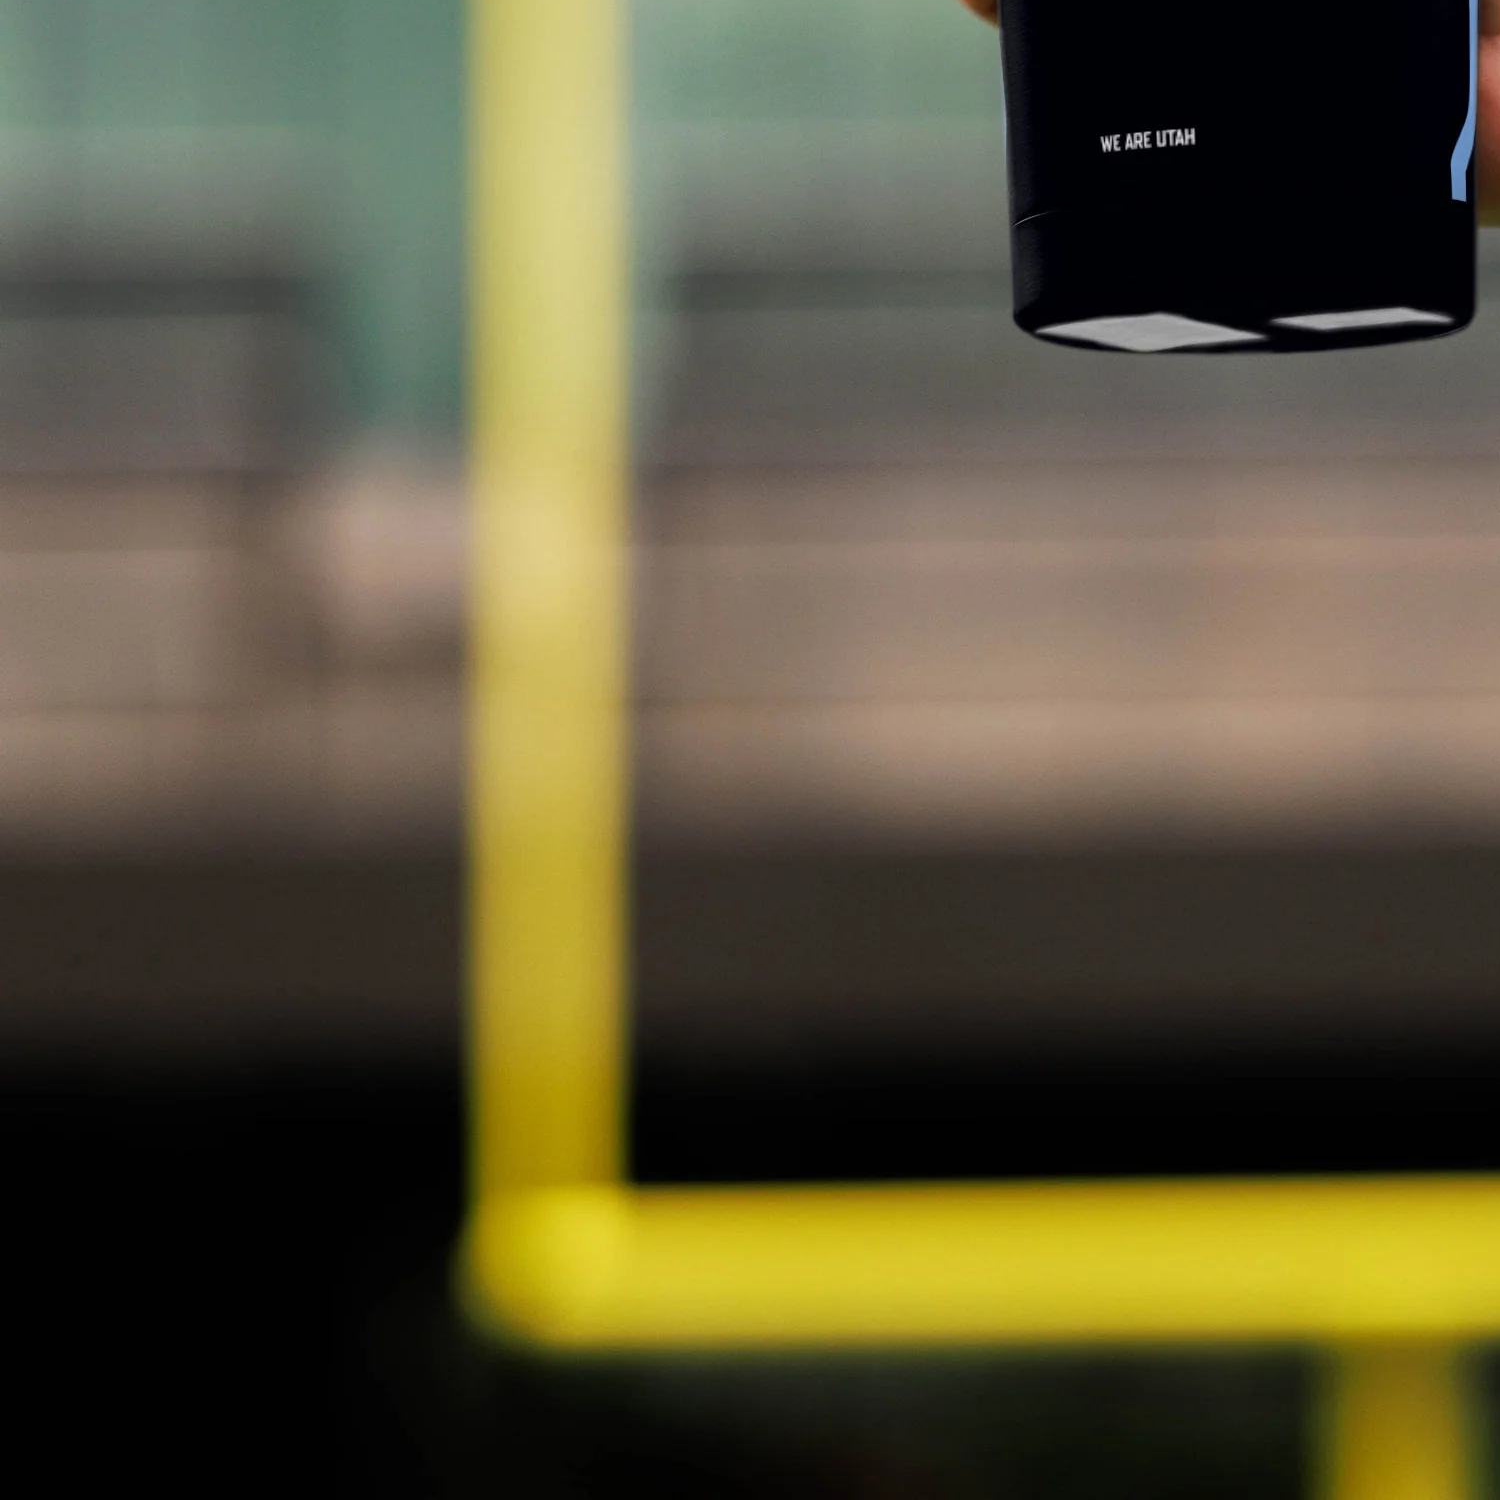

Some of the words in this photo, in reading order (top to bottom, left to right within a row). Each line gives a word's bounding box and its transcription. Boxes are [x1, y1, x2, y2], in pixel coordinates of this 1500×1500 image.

[1100, 134, 1121, 153] WE
[1125, 131, 1152, 150] ARE
[1156, 128, 1196, 148] UTAH
